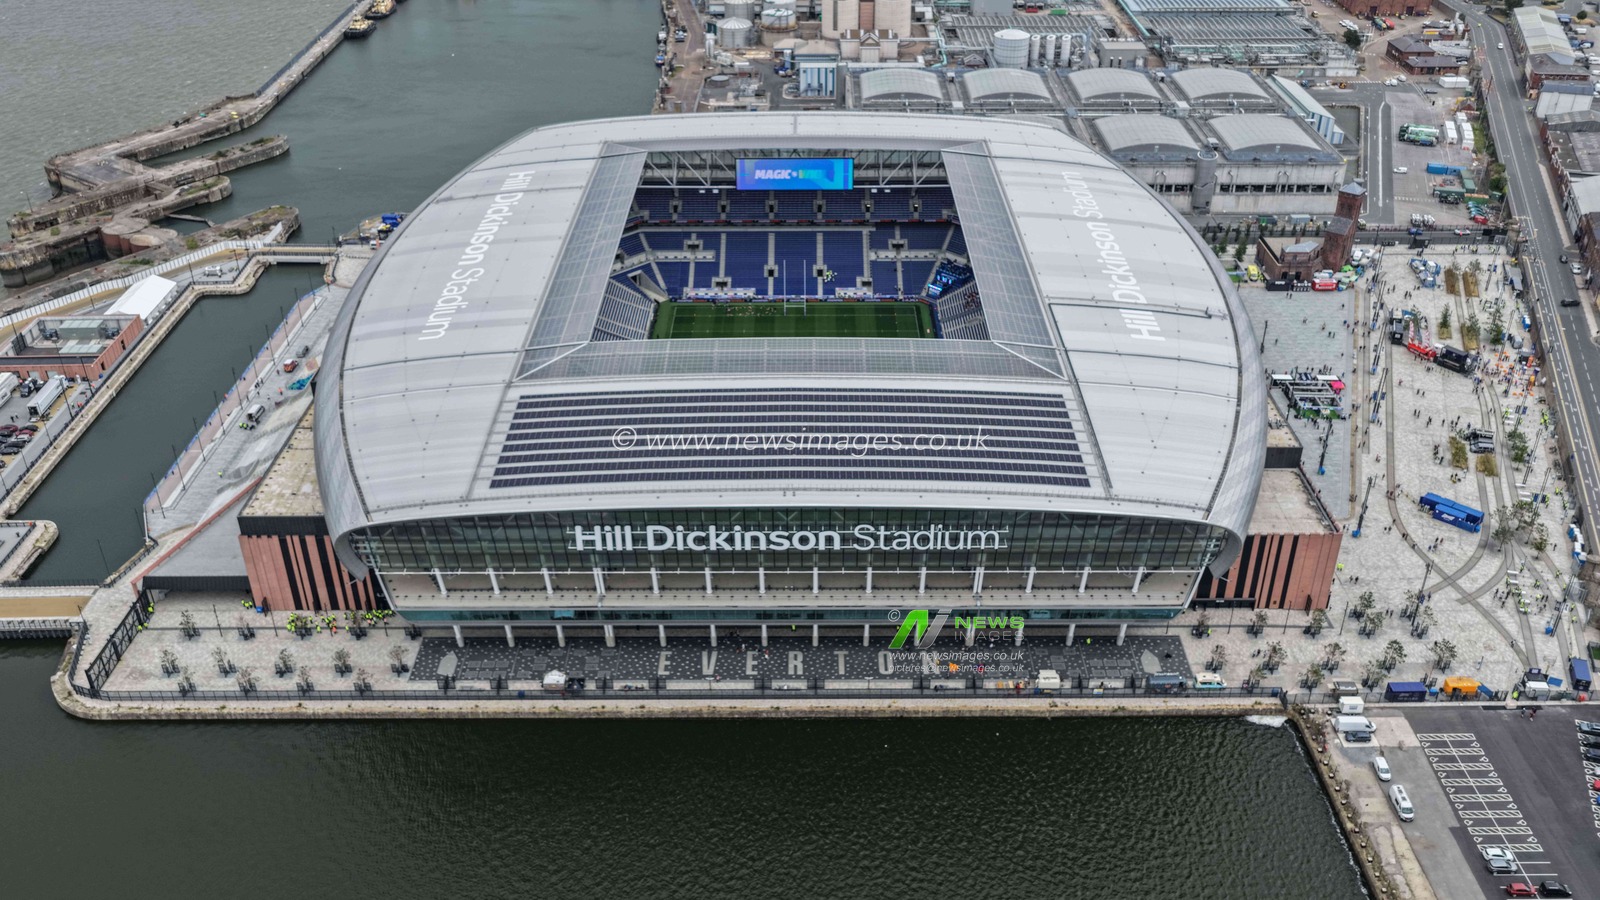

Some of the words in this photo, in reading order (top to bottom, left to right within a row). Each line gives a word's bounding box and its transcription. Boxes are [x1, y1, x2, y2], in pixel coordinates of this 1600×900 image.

[500, 170, 536, 191] Hill
[755, 169, 791, 179] MAGIC
[1062, 171, 1104, 219] Stadium
[458, 192, 524, 265] Dickinson
[1087, 221, 1148, 305] Dickinson
[418, 268, 485, 341] Stadium
[1119, 308, 1166, 341] Hill
[575, 525, 633, 551] Hill
[646, 525, 841, 551] Dickinson
[853, 524, 1001, 551] Stadium
[657, 650, 941, 675] EVERTON
